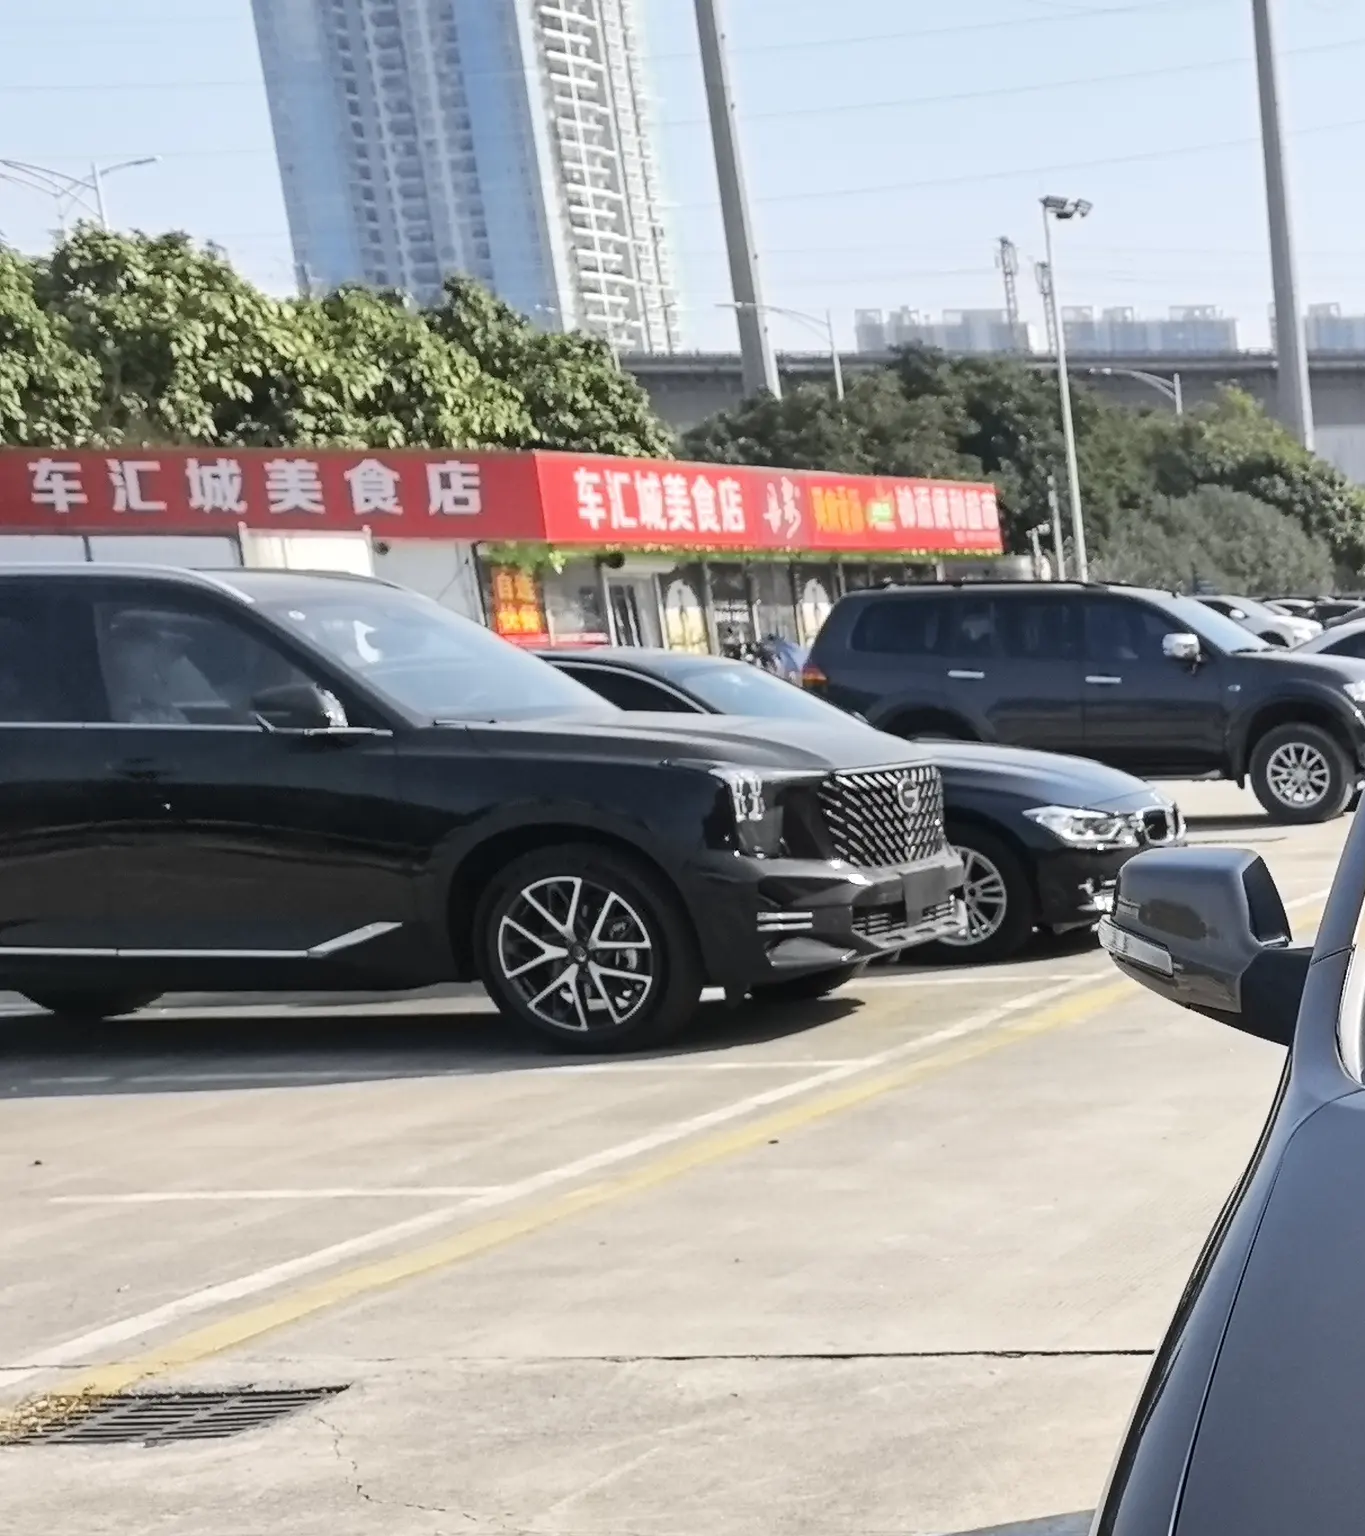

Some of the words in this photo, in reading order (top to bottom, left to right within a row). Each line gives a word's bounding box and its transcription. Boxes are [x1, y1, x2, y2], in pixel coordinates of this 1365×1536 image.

[27, 457, 483, 515] 车汇城美食店
[573, 466, 747, 534] 车汇城美食店
